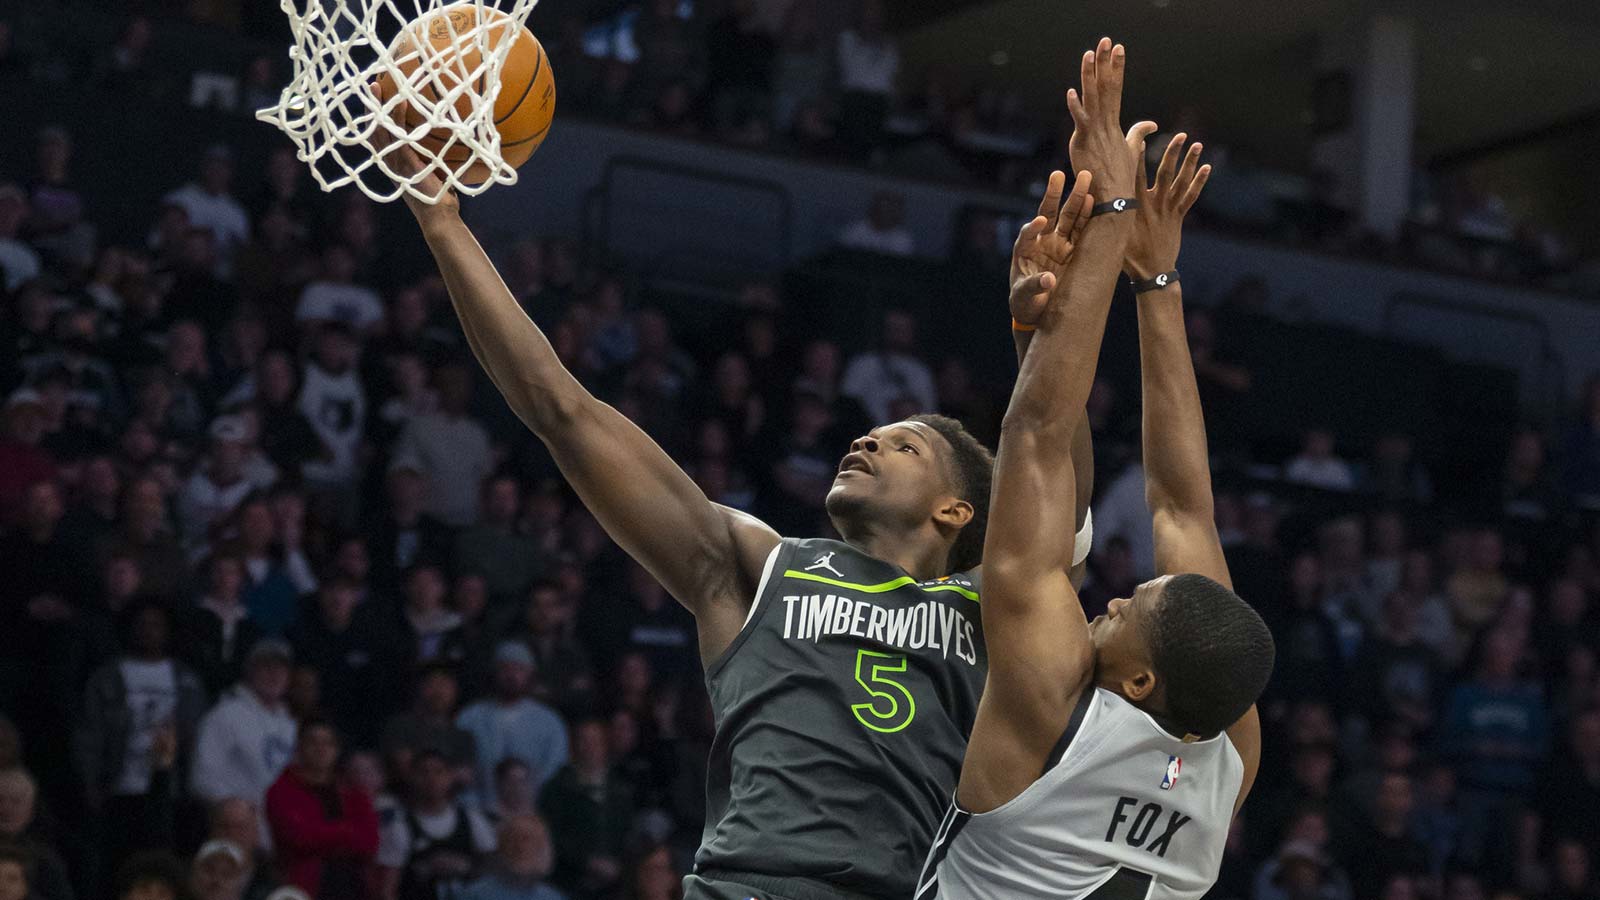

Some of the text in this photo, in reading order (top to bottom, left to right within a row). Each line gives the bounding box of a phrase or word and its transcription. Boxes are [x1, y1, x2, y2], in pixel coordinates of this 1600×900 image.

[783, 595, 977, 666] TIMBERWOLVES
[851, 649, 915, 733] 5
[1104, 796, 1192, 858] FOX
